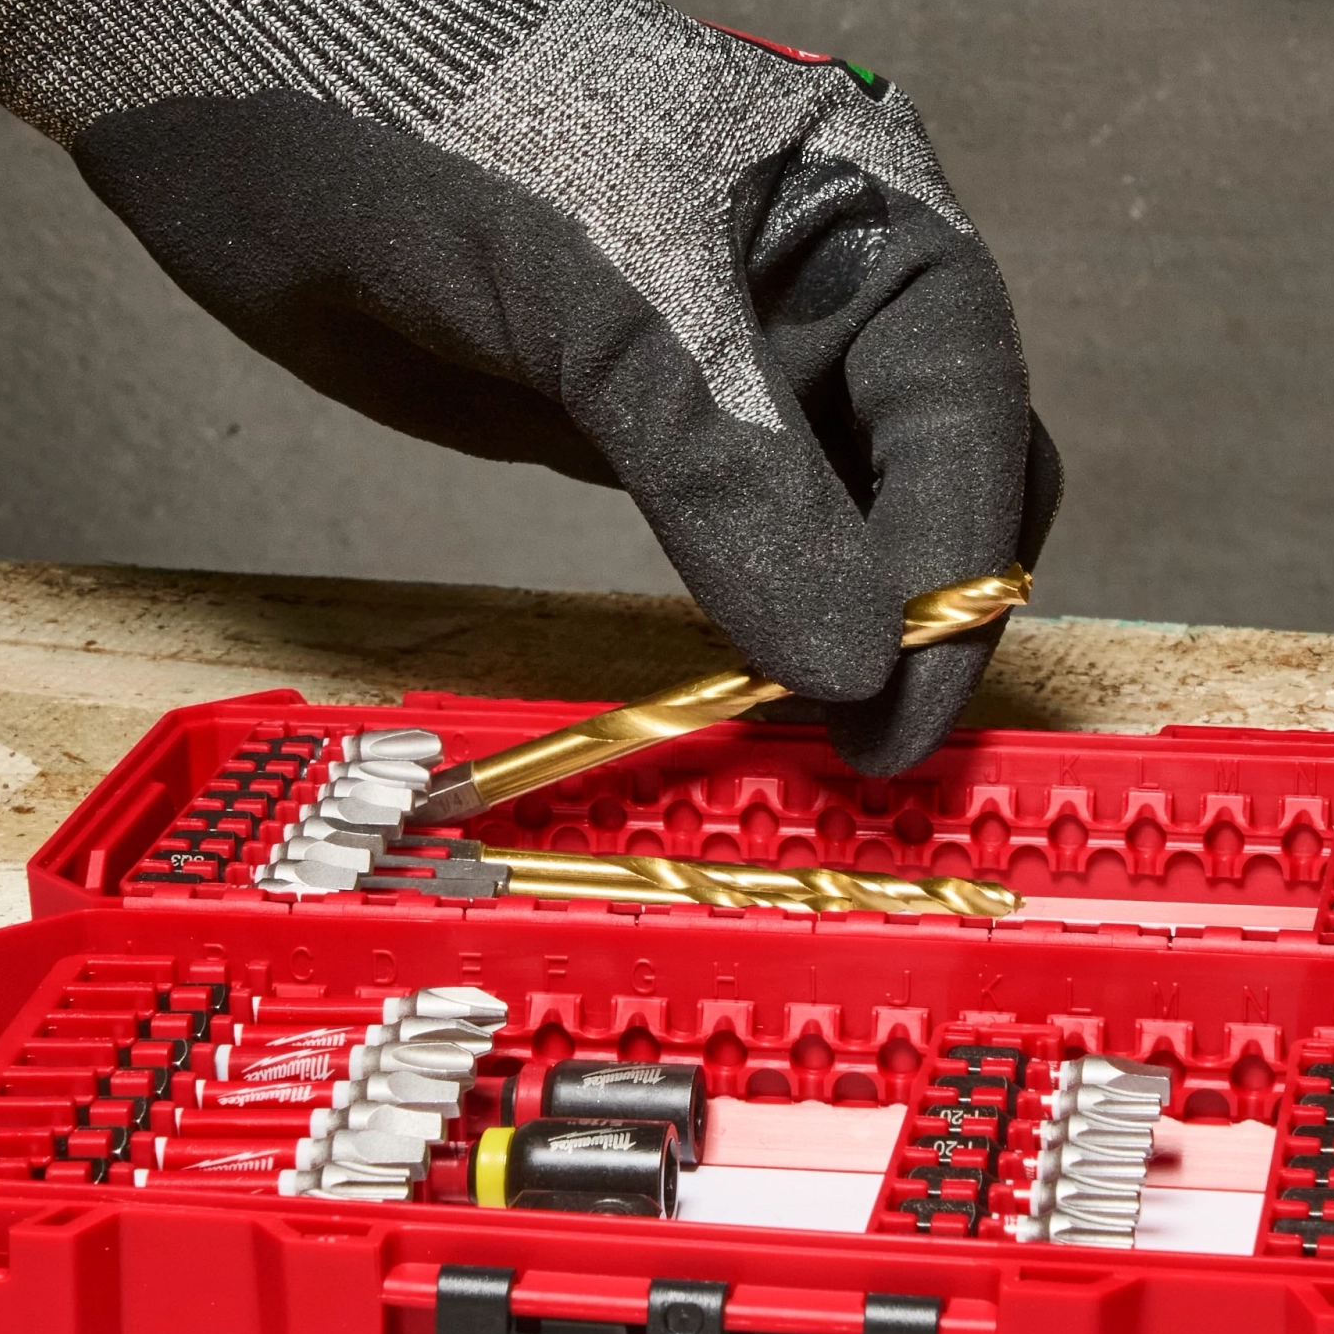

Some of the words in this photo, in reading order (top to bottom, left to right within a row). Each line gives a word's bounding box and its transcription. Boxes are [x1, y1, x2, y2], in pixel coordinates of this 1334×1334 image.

[1059, 753, 1081, 786] K
[1137, 756, 1160, 789] L
[1214, 758, 1240, 793] M
[1295, 761, 1318, 795] N
[290, 946, 315, 981] C
[371, 948, 397, 984] D
[458, 952, 484, 988] E
[543, 954, 569, 992] F
[631, 957, 657, 995] G
[713, 961, 739, 999] H
[886, 969, 911, 1007] J
[977, 973, 1004, 1010] K
[1066, 977, 1092, 1015] L
[1151, 980, 1179, 1018] M
[1243, 985, 1269, 1023] N
[243, 1053, 335, 1081] Milwaukee
[582, 1067, 667, 1089] Milwaukee
[217, 1084, 318, 1107] Milwaukee
[548, 1132, 637, 1155] Milwaukee
